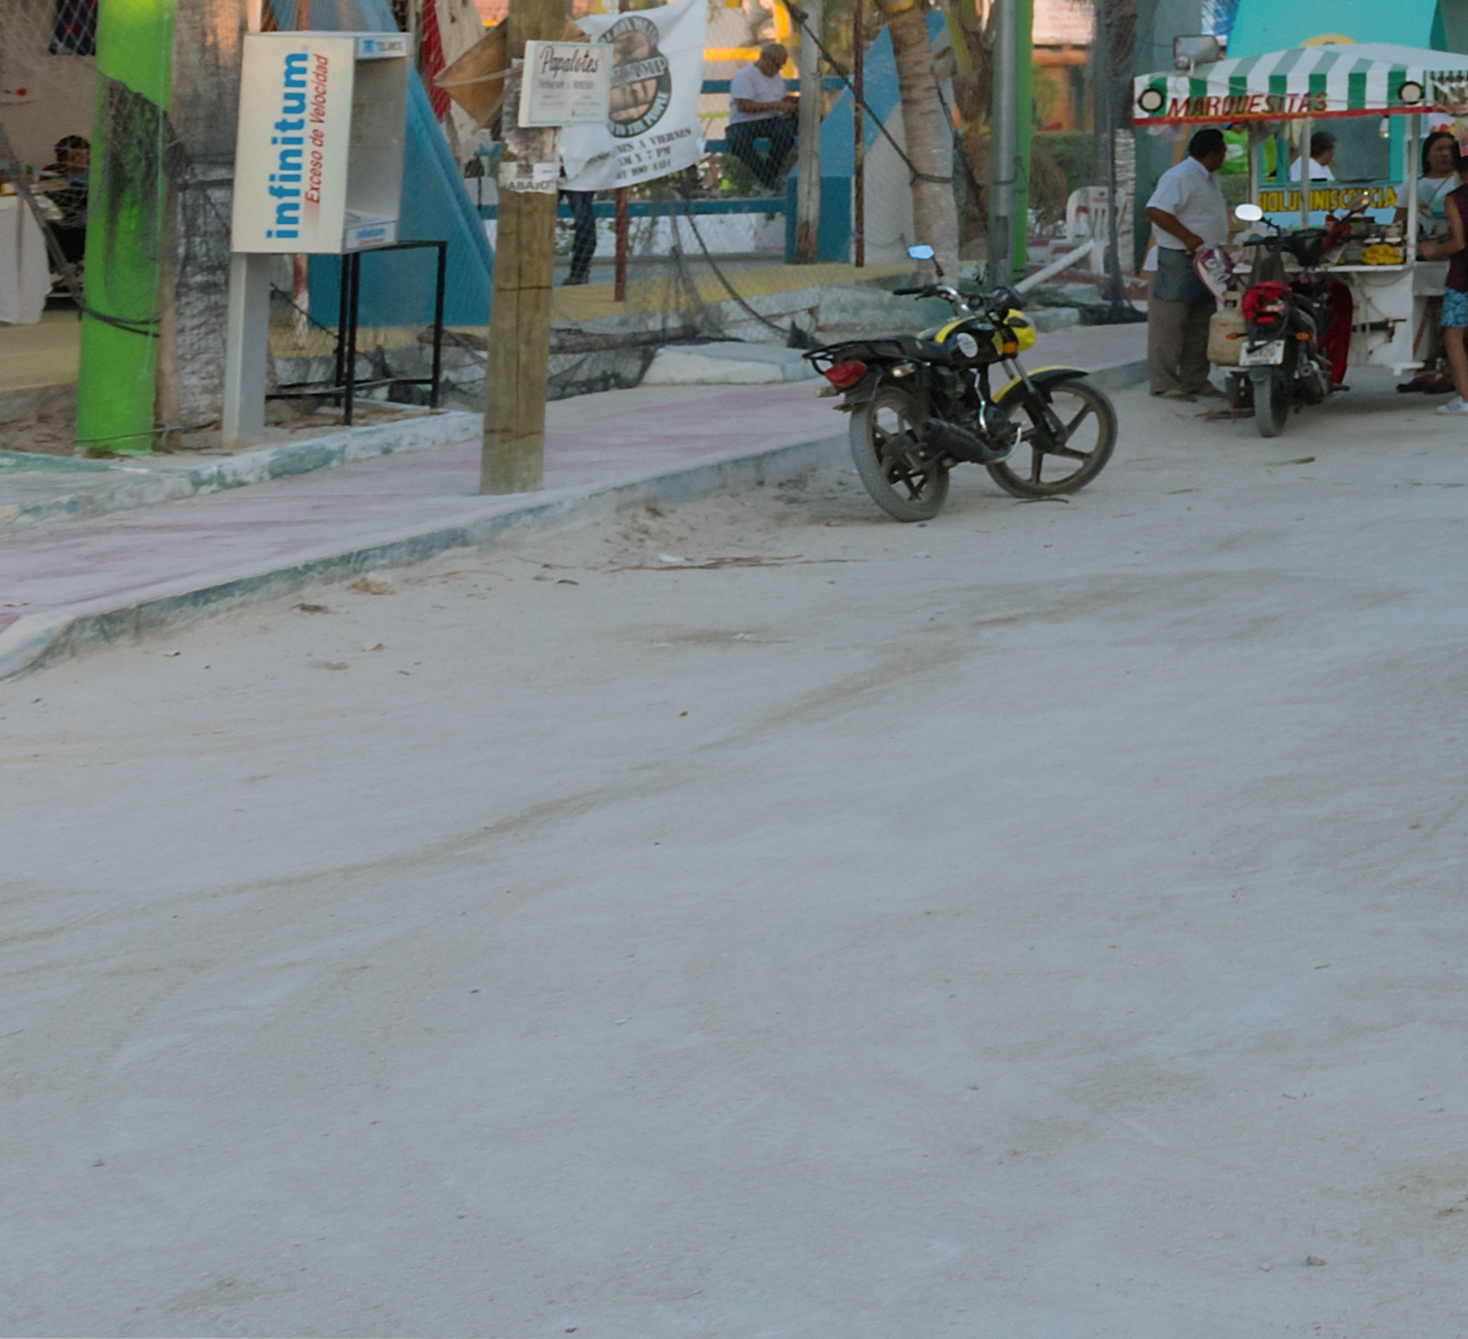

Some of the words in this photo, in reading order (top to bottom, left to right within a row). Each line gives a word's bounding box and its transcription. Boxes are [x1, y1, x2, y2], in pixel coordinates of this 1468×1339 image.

[308, 53, 329, 125] Velocidad
[1166, 92, 1329, 119] MARQUESITAS
[265, 52, 309, 239] infinitum
[308, 128, 325, 149] de
[304, 149, 324, 205] Exceso
